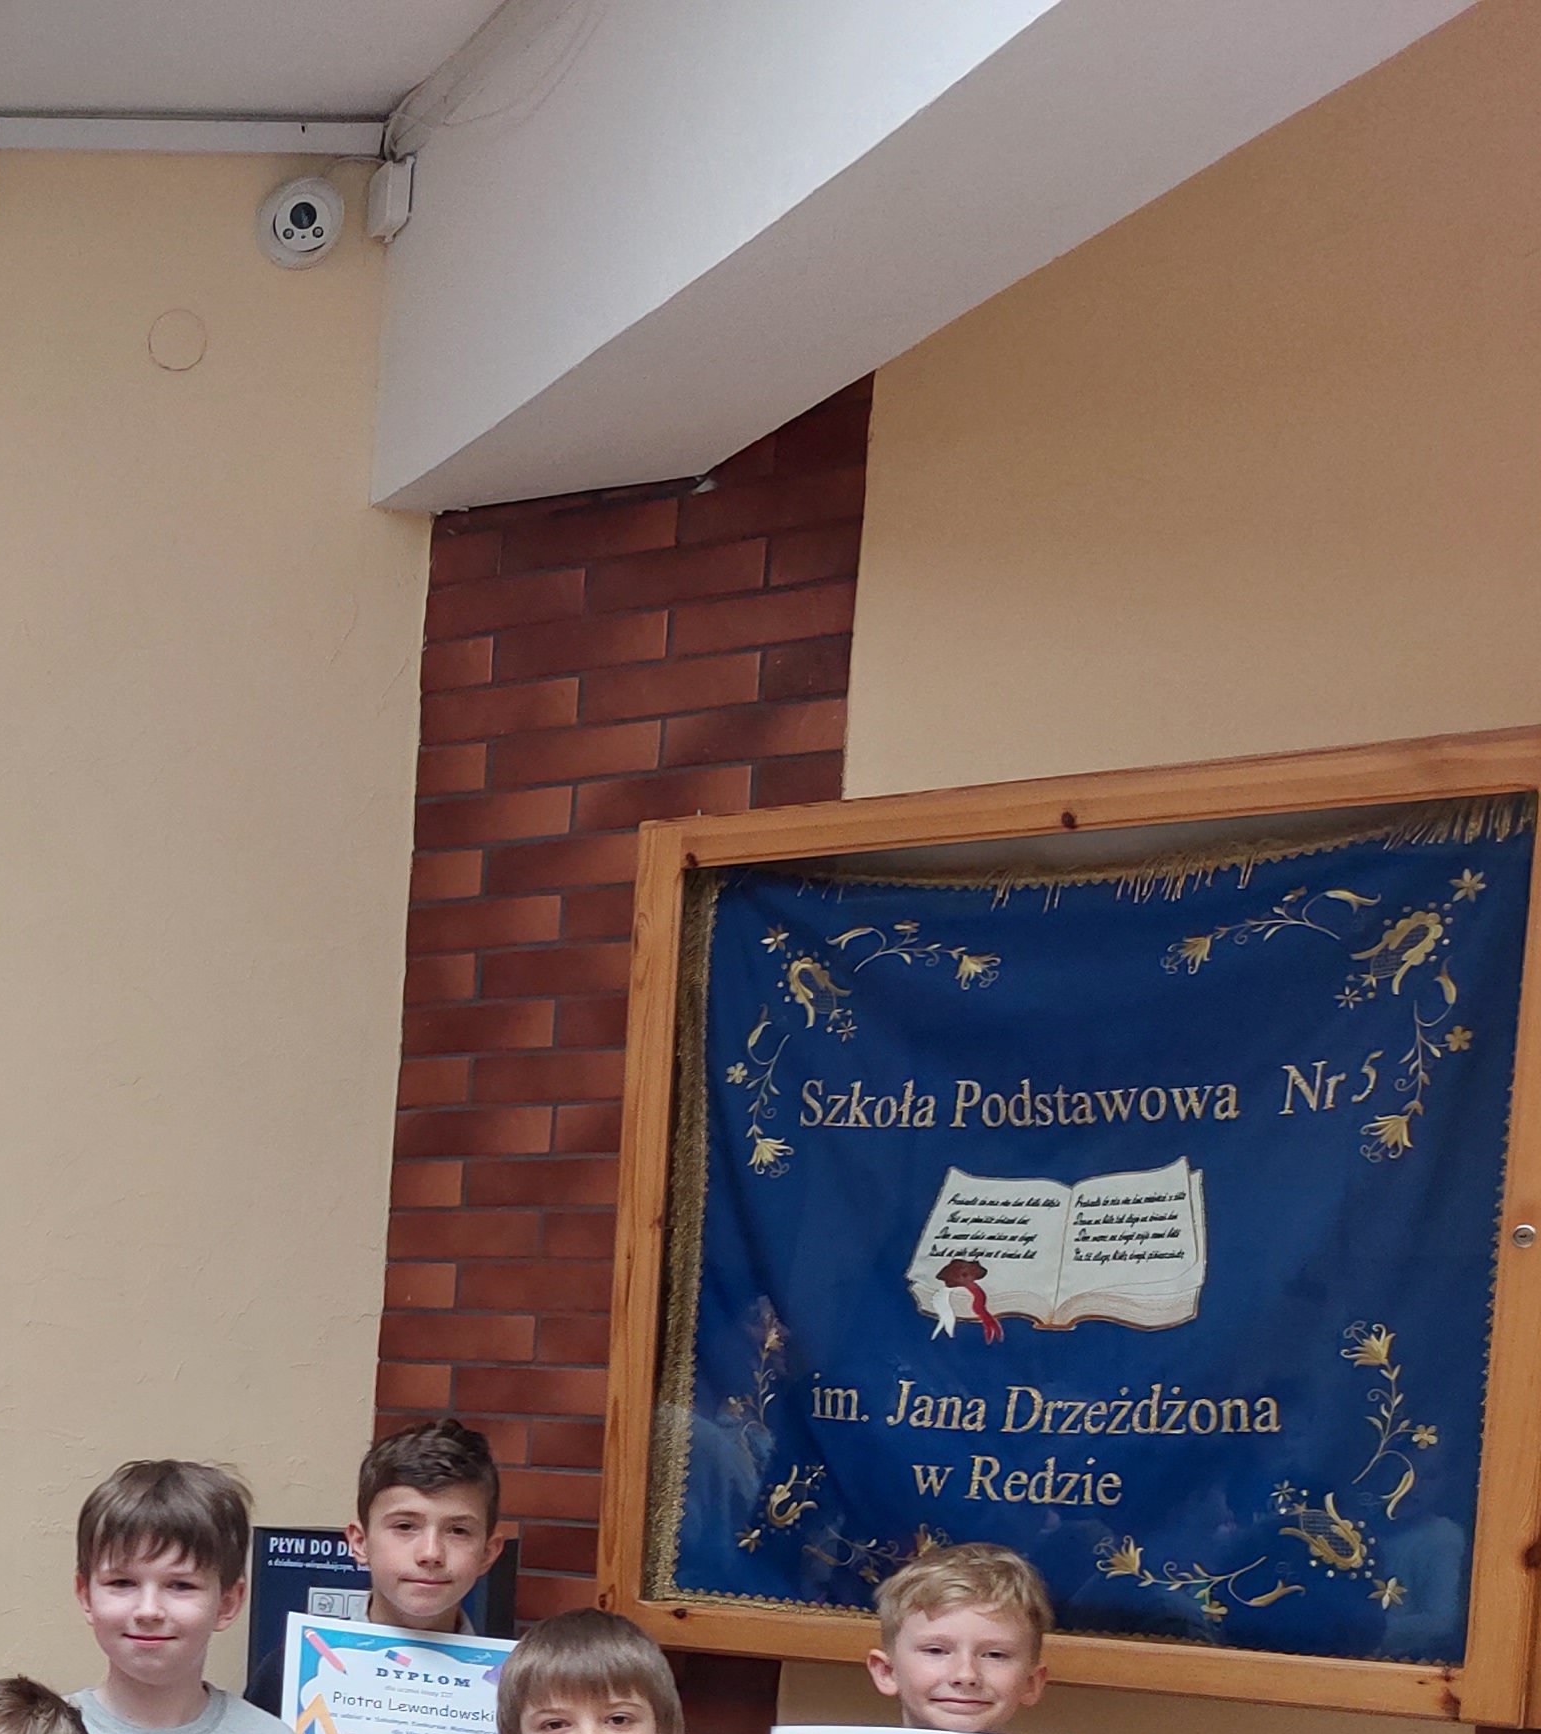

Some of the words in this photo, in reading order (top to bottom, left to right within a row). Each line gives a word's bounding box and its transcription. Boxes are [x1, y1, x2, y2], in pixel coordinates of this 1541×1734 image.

[799, 1079, 936, 1128] Szkoła
[950, 1078, 1240, 1129] Podstawowa
[1278, 1061, 1346, 1115] Nr
[1350, 1049, 1384, 1103] 5
[811, 1373, 870, 1422] im.
[886, 1380, 987, 1432] Jana
[1000, 1383, 1281, 1434] Drzeżdżona
[912, 1463, 954, 1497] w
[964, 1455, 1122, 1505] Redzie
[269, 1537, 305, 1554] PŁYN
[310, 1540, 332, 1555] DO
[376, 1668, 471, 1688] DYPLOM
[333, 1691, 382, 1709] Piotra
[388, 1698, 495, 1722] Lewandowski
